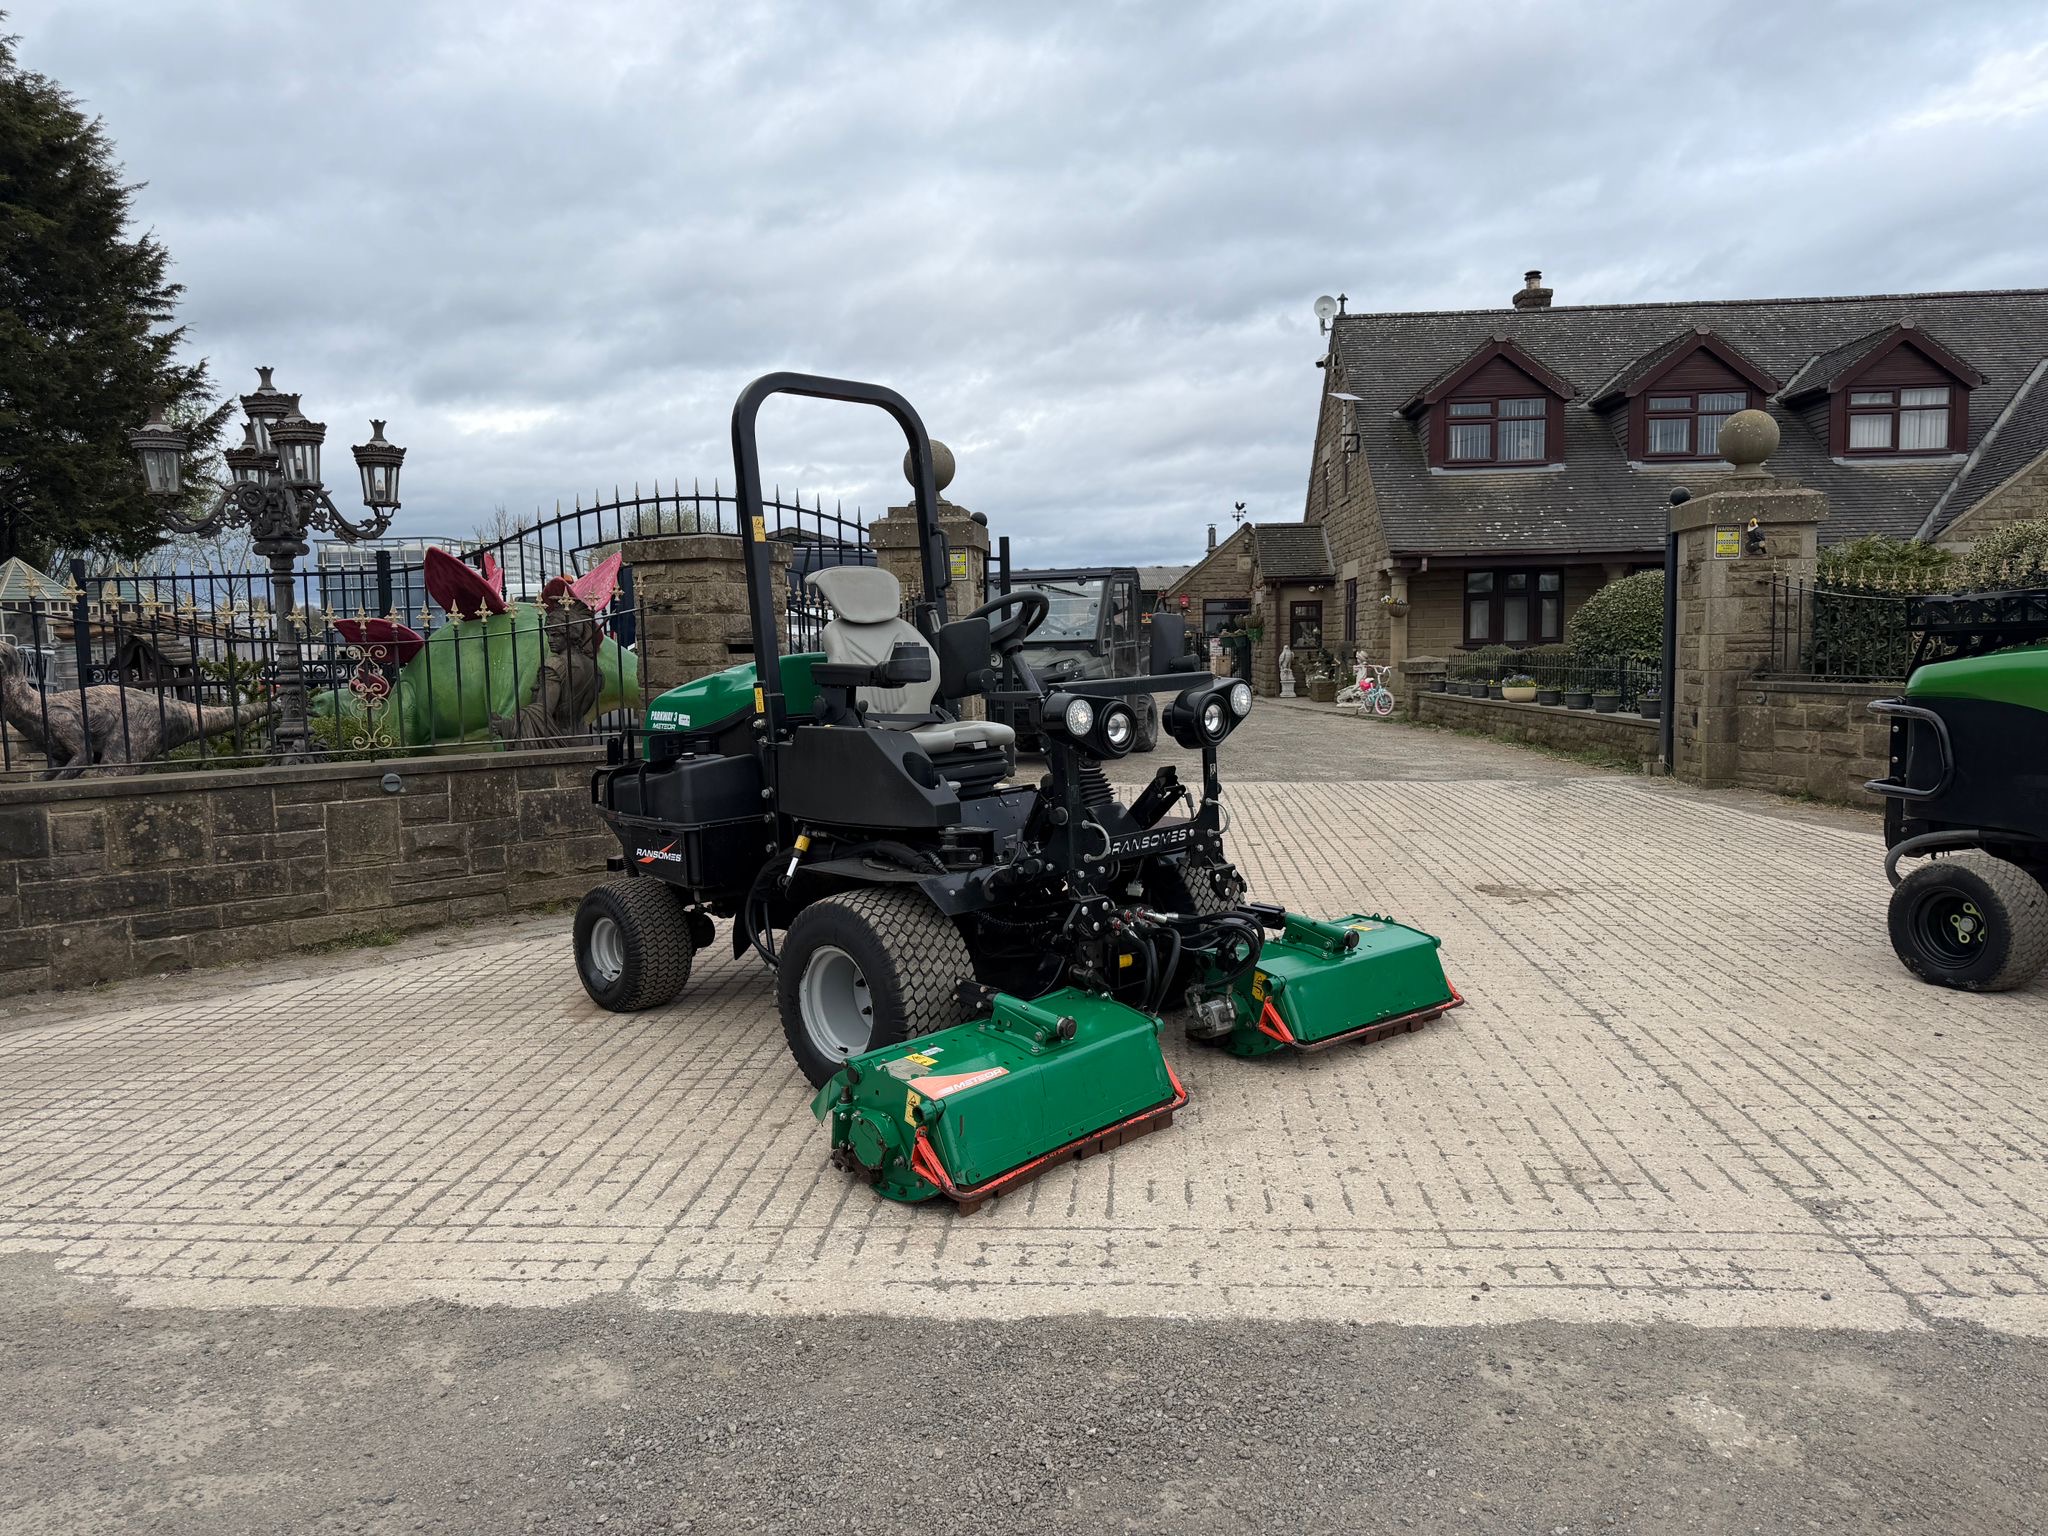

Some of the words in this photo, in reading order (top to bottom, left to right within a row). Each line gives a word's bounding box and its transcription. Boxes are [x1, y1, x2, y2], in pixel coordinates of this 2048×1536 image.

[651, 711, 673, 721] PARKWAY
[674, 712, 678, 722] 3
[1112, 829, 1186, 855] RANSOMES
[636, 848, 681, 862] RANSOMES
[953, 1068, 1002, 1090] METEOR
